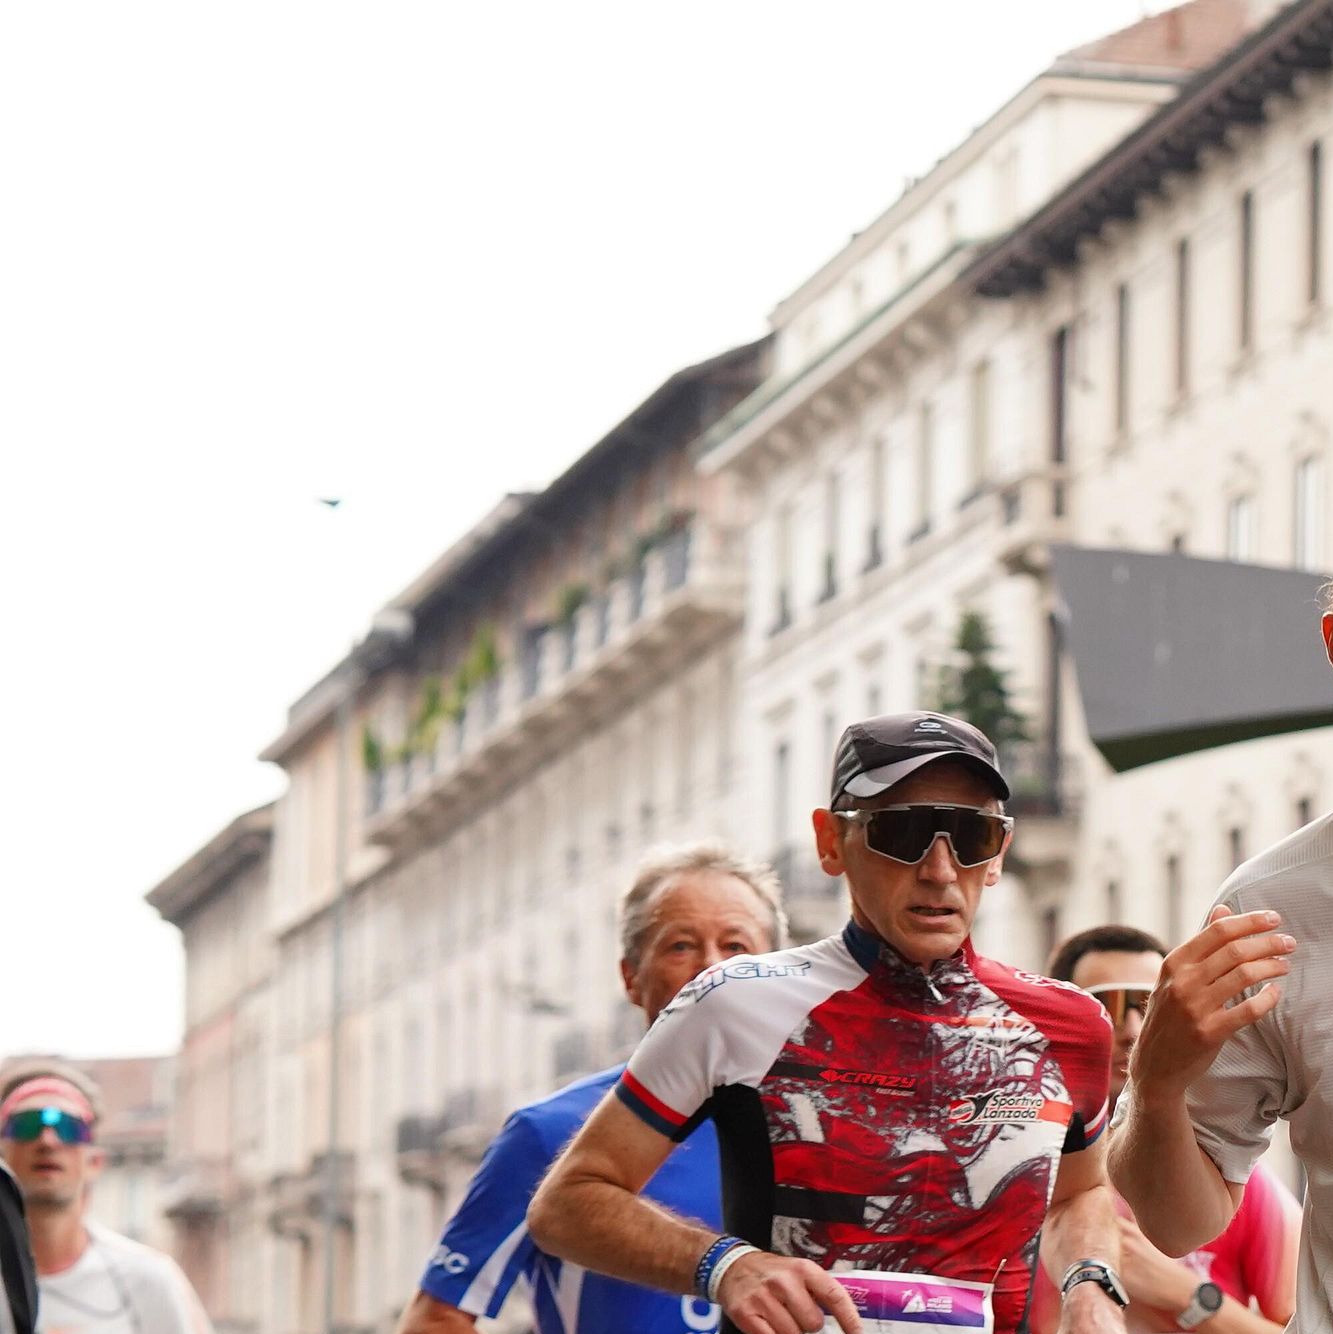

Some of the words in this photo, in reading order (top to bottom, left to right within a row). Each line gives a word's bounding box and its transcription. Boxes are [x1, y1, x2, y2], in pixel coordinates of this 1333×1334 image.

[839, 1072, 917, 1089] CRAZY
[991, 1094, 1043, 1109] Sportiva
[982, 1106, 1037, 1120] Lanzada
